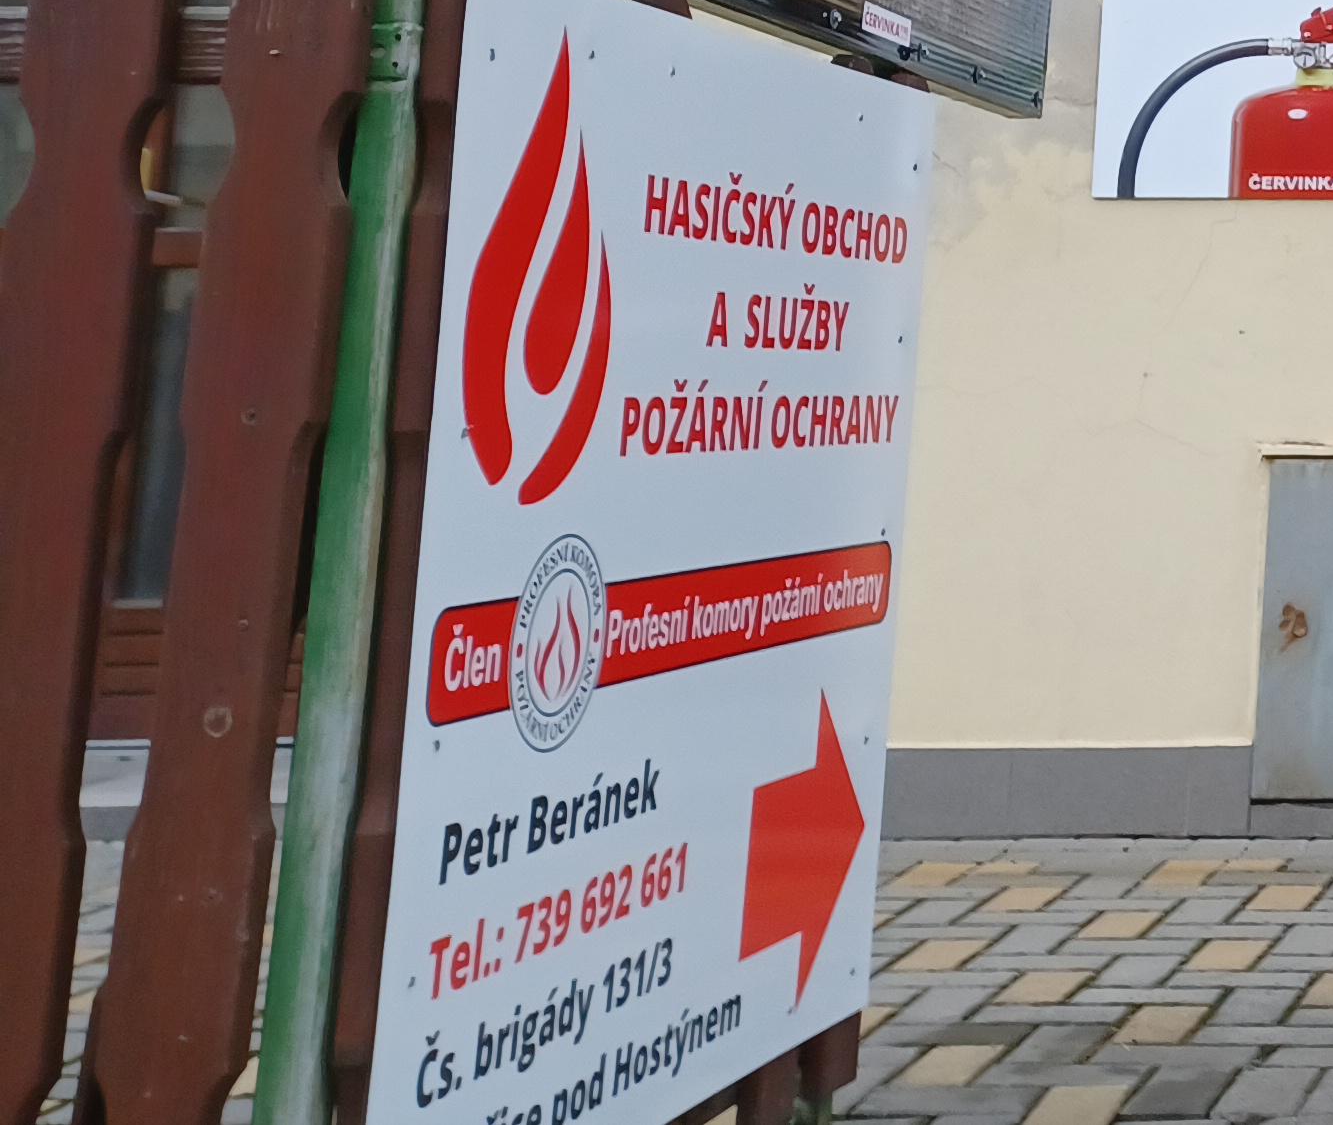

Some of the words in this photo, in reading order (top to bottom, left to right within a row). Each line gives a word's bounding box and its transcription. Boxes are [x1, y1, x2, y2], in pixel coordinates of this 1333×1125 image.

[643, 172, 795, 251] HASIČSKÝ
[801, 202, 908, 265] OBCHOD
[706, 291, 729, 348] A
[744, 283, 850, 352] SLUŽBY
[619, 379, 769, 457] POŽÁRNÍ
[770, 394, 899, 449] OCHRANY
[444, 623, 501, 691] Člen
[606, 599, 691, 658] Profesní
[692, 594, 760, 641] komory
[760, 576, 823, 636] požární
[823, 569, 884, 614] ochrany
[438, 813, 519, 885] Petr
[526, 758, 660, 854] Beránek
[429, 918, 505, 1000] Tel.:
[514, 889, 572, 964] 739
[580, 864, 633, 934] 692
[641, 842, 688, 908] 661
[416, 1030, 463, 1109] Čs.
[473, 978, 595, 1081] brigády
[603, 937, 673, 1013] 131/3
[552, 1051, 606, 1125] pod
[612, 994, 742, 1097] Hostýnem
